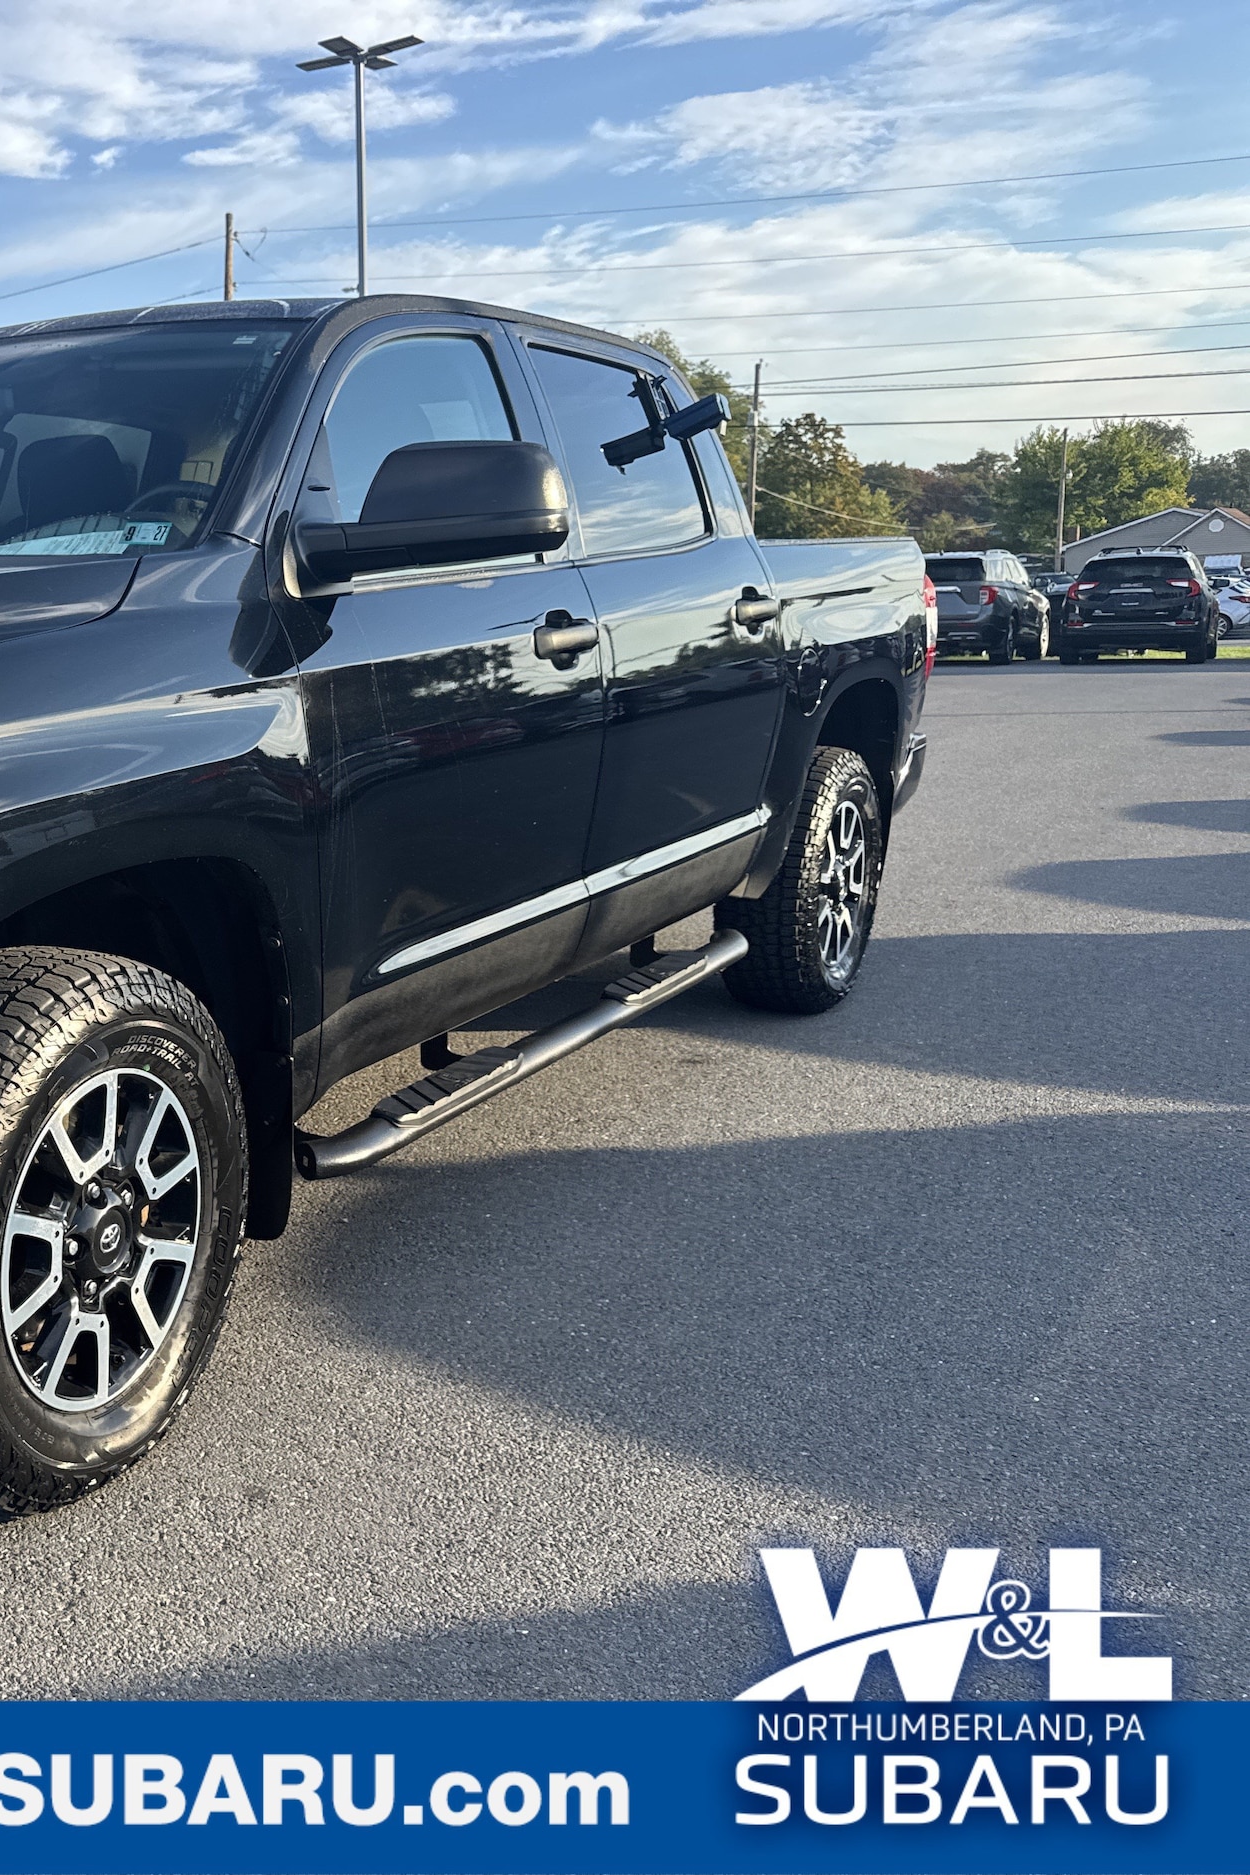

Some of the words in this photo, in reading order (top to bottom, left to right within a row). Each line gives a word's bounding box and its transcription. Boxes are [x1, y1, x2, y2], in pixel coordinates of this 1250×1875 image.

[153, 525, 169, 541] 27
[127, 1034, 197, 1070] DISCOVERER
[184, 1071, 200, 1087] AT
[170, 1205, 232, 1389] COOPER
